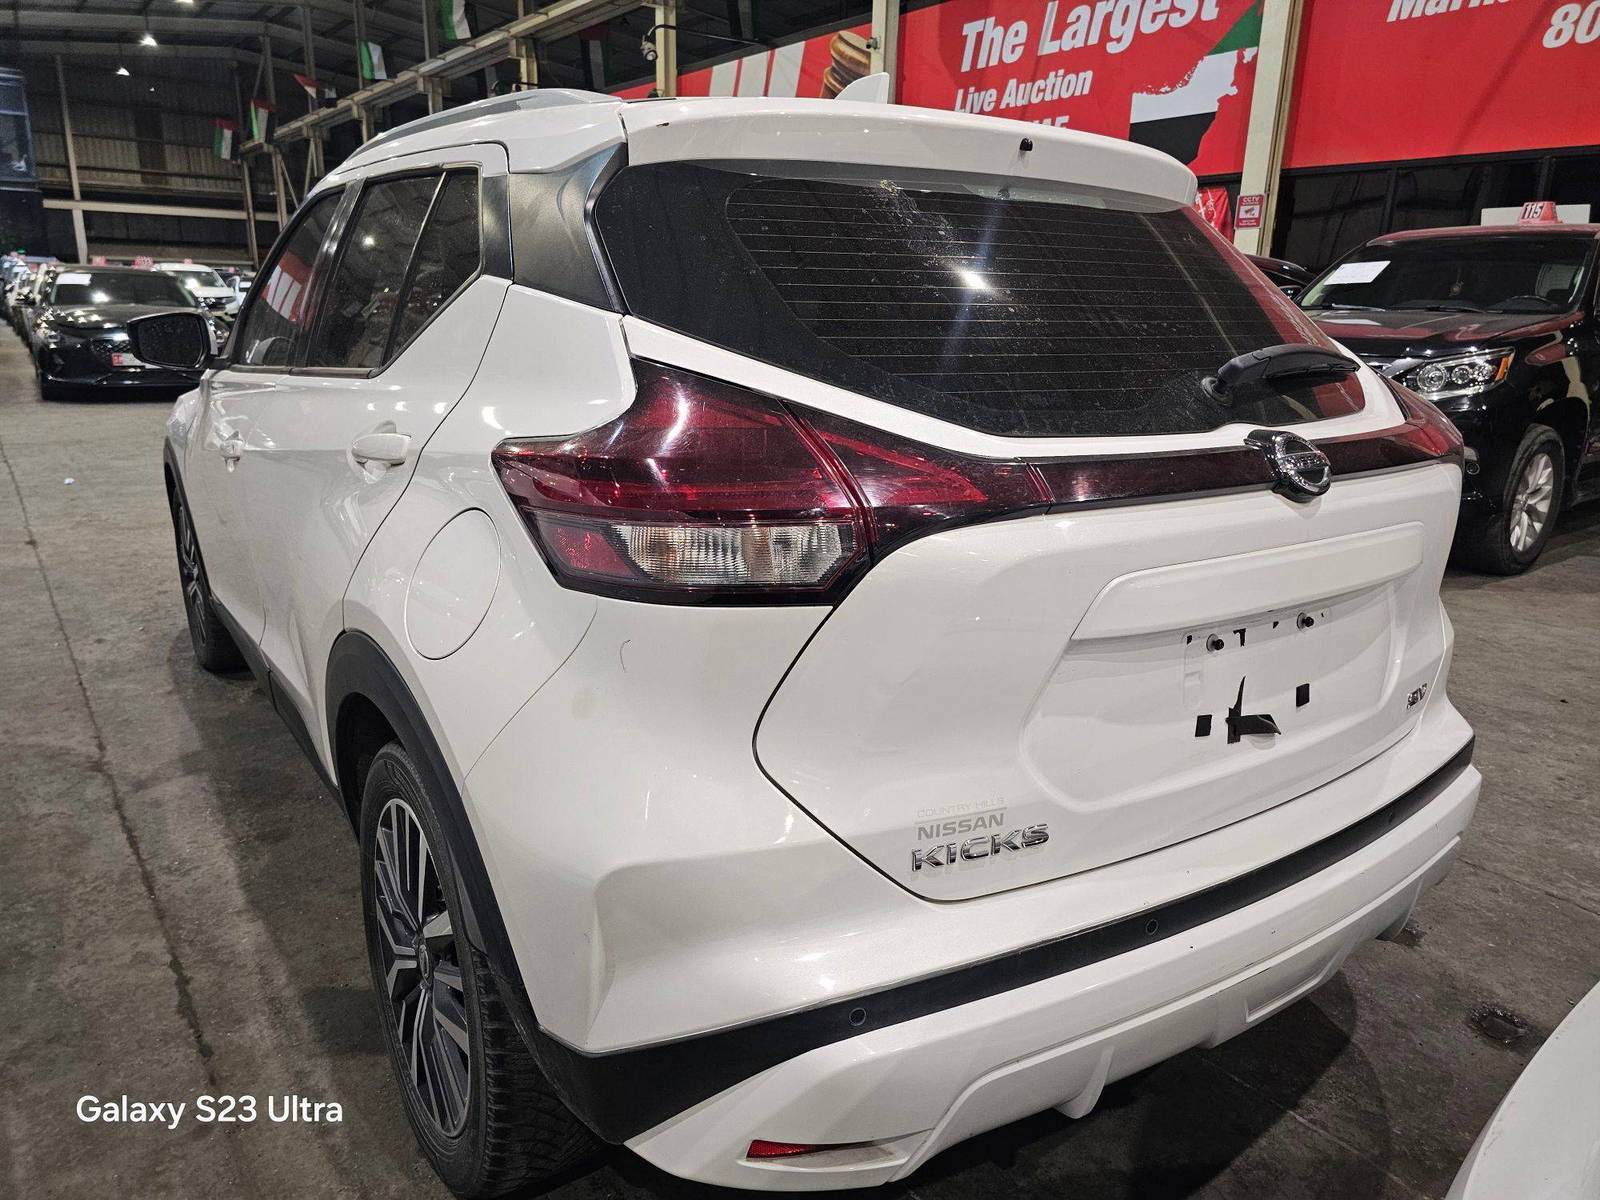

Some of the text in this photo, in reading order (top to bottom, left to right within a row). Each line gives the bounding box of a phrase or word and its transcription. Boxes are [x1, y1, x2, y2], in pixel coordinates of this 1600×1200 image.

[960, 0, 1219, 73] The Largest
[954, 69, 1094, 114] Live Auction
[1521, 203, 1544, 220] 115
[911, 823, 1050, 872] KICKS
[917, 813, 1005, 841] NISSAN
